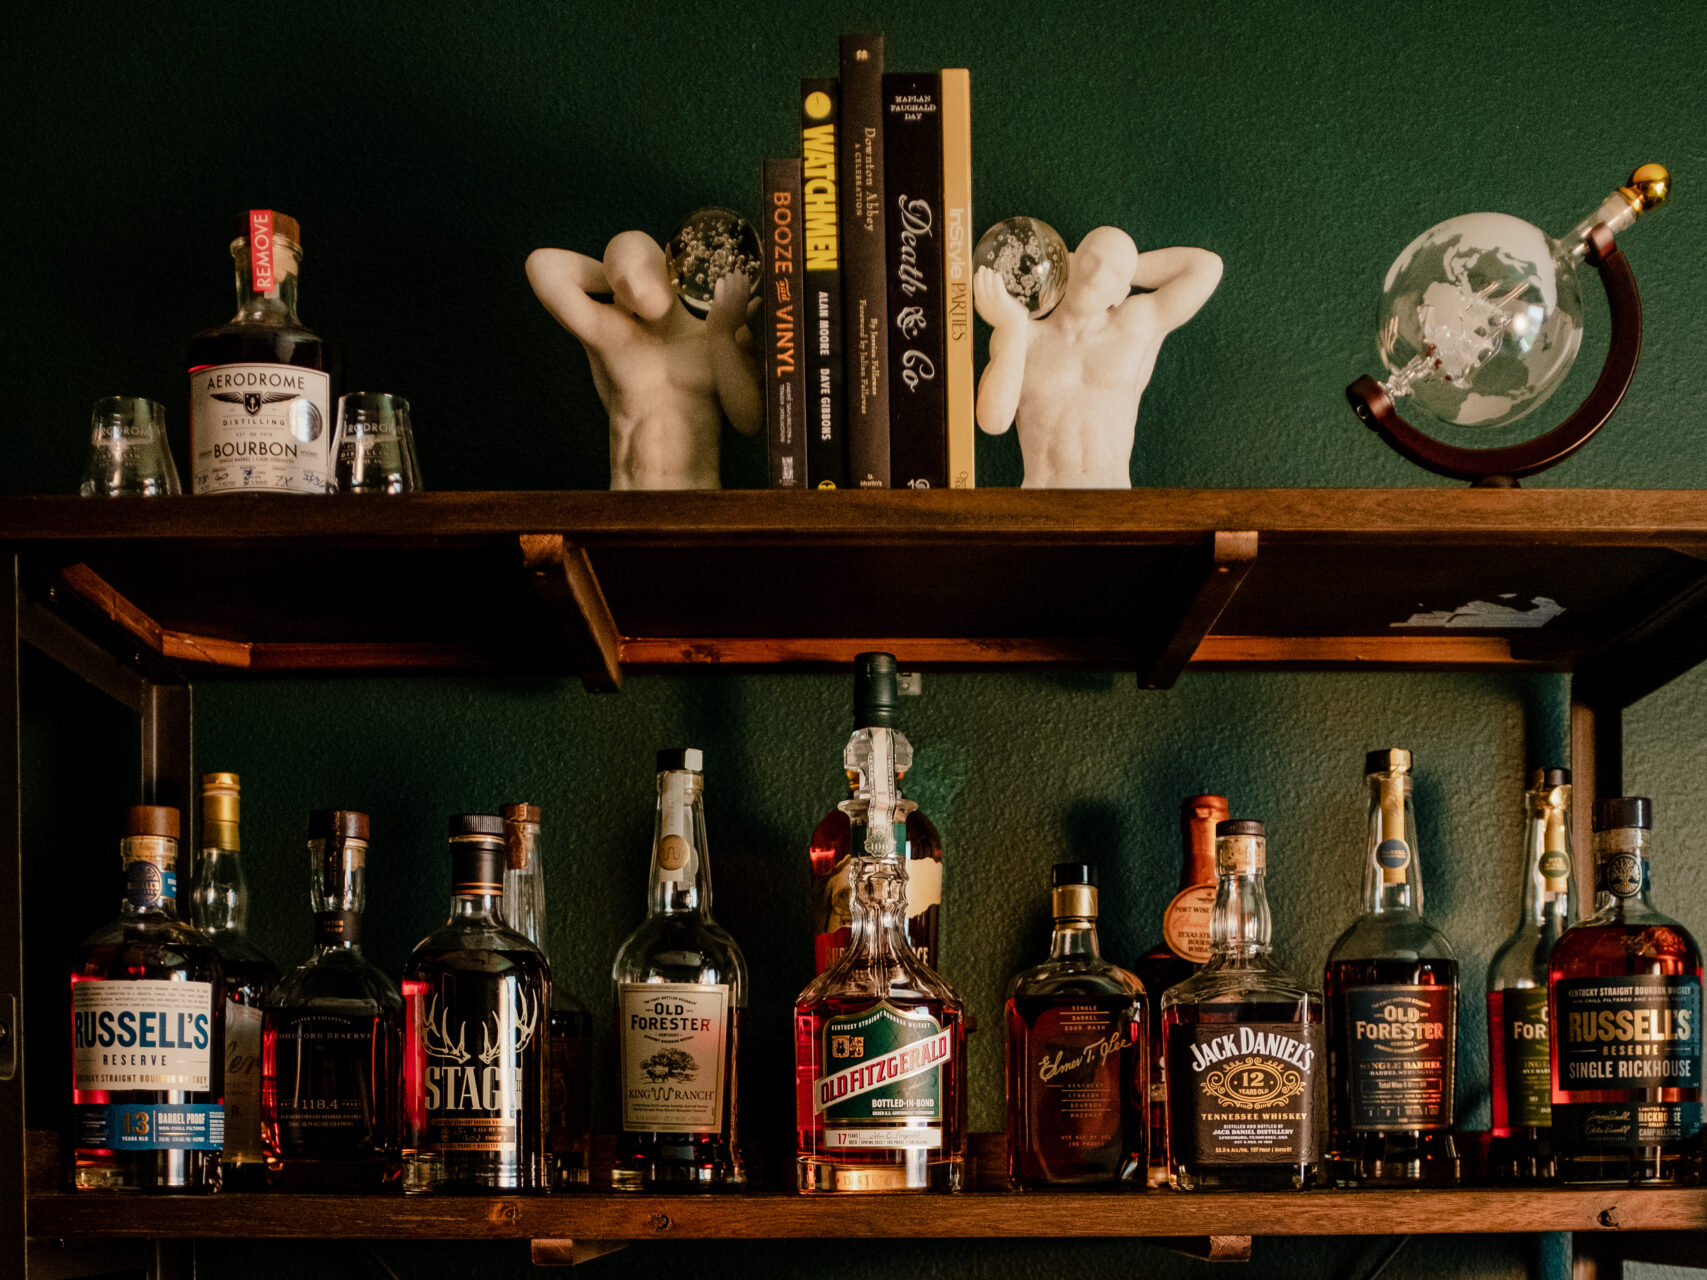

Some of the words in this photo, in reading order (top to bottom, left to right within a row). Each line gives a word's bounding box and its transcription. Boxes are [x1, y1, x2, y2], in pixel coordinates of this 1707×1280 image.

[904, 112, 922, 120] DAY
[864, 127, 876, 186] Downton
[854, 153, 863, 216] CELEBRATION
[803, 124, 838, 271] WATCHMEN
[864, 191, 880, 232] Abbey
[773, 192, 793, 274] BOOZE
[253, 212, 272, 288] REMOVE
[898, 194, 933, 297] Death
[949, 208, 966, 280] InStyle
[818, 291, 829, 318] ALAN
[951, 282, 968, 342] PARTIES
[776, 306, 795, 377] VINYL
[819, 320, 830, 356] MOORE
[207, 372, 305, 390] AERODROME
[820, 368, 831, 395] DAVE
[902, 349, 935, 393] Co
[222, 419, 285, 427] DISTILLING
[820, 397, 832, 441] GIBBONS
[214, 441, 298, 459] BOURBON
[1568, 989, 1598, 998] KENTUCKY
[1599, 987, 1634, 996] STRAIGHT
[1635, 986, 1666, 995] BOURBON
[654, 1002, 684, 1016] OLD
[1383, 1005, 1420, 1022] OLD
[74, 1010, 209, 1050] RUSSELL'S
[631, 1014, 711, 1032] FORESTER
[831, 1023, 857, 1031] KENTUCKY
[1355, 1020, 1444, 1039] FORESTER
[1568, 1009, 1692, 1042] RUSSELL'S
[102, 1054, 167, 1067] RESERVE
[1038, 1050, 1083, 1082] Elmer
[1100, 1031, 1133, 1066] Lee
[1189, 1033, 1240, 1072] JACK
[1239, 1027, 1315, 1073] DANIEL'S
[1602, 1044, 1659, 1056] RESERVE
[100, 1074, 137, 1083] STRAIGHT
[820, 1075, 848, 1104] OLD
[849, 1035, 948, 1093] FITZGERALD
[1241, 1072, 1265, 1087] 12
[1569, 1061, 1614, 1079] SINGLE
[1618, 1060, 1692, 1078] RICKHOUSE
[302, 1099, 339, 1110] 118.4
[629, 1088, 650, 1100] KING
[674, 1090, 713, 1100] RANCH
[872, 1098, 935, 1108] BOTTLED-IN-BOND
[124, 1111, 150, 1135] 13
[158, 1113, 185, 1124] BARREL
[186, 1113, 206, 1124] PROOF
[1201, 1112, 1260, 1120] TENNESSEE
[1262, 1112, 1308, 1120] WHISKEY
[837, 1133, 847, 1145] 17
